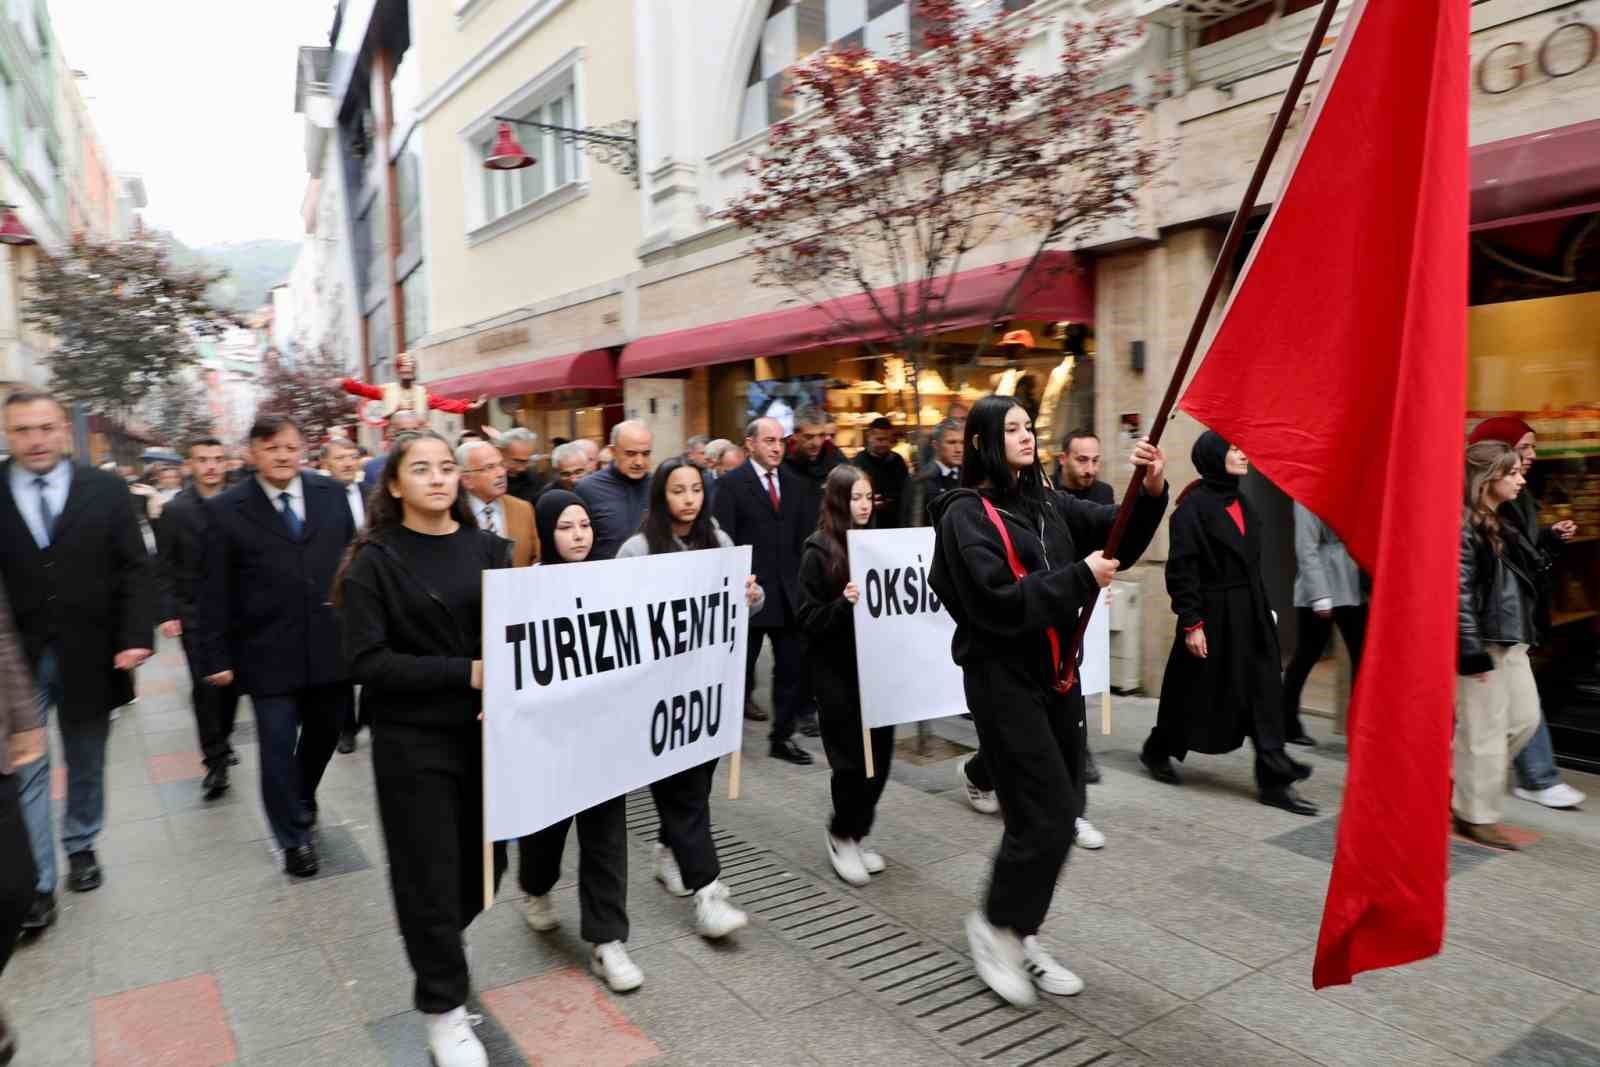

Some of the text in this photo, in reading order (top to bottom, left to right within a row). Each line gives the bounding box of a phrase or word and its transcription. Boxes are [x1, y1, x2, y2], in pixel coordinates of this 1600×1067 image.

[505, 576, 737, 691] TURİZM KENTİ;
[650, 683, 723, 757] ORDU
